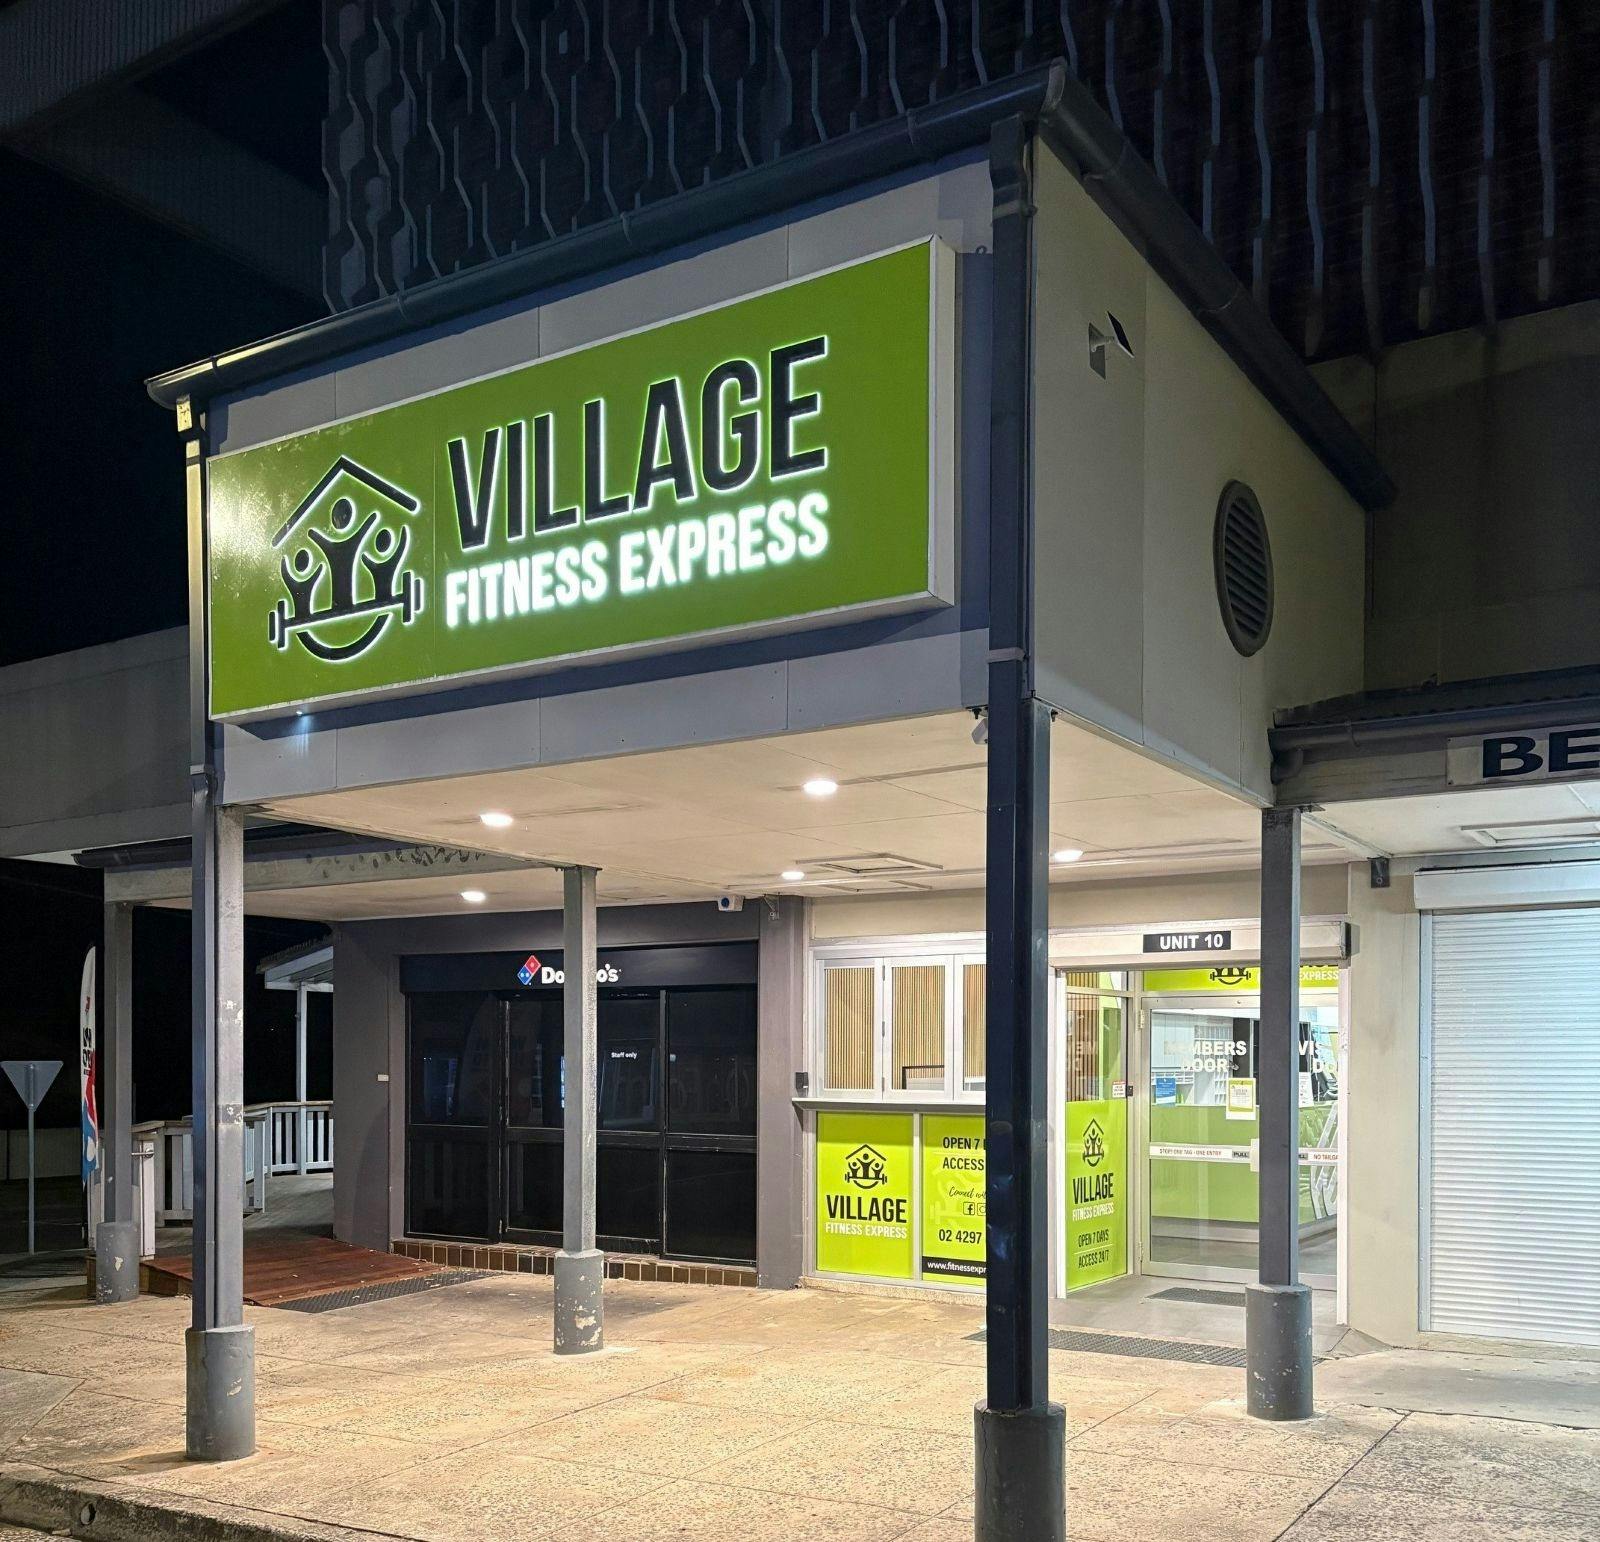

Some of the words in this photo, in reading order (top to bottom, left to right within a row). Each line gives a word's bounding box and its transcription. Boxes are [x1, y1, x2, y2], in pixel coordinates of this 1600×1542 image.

[447, 335, 828, 553] VILLAGE
[446, 539, 608, 629] FITNESS
[618, 492, 829, 596] EXPRESS
[1483, 728, 1600, 778] BE
[1159, 935, 1199, 950] UNIT
[1204, 933, 1224, 948] 10
[541, 963, 619, 984] Doo's
[625, 1052, 637, 1060] only
[942, 1136, 971, 1150] OPEN
[974, 1138, 981, 1150] 7
[942, 1157, 985, 1171] ACCESS
[1072, 1172, 1114, 1204] VILLAGE
[826, 1194, 907, 1223] VILLAGE
[1072, 1206, 1093, 1221] FITNESS
[1093, 1202, 1114, 1217] EXPRESS
[825, 1222, 863, 1235] FITNESS
[865, 1225, 907, 1239] EXPRESS
[938, 1229, 952, 1242] 02
[955, 1230, 982, 1244] 4297
[1078, 1233, 1092, 1247] OPEN
[1096, 1229, 1109, 1243] DAYS
[1078, 1252, 1098, 1269] ACCESS
[1098, 1250, 1109, 1263] 24/7
